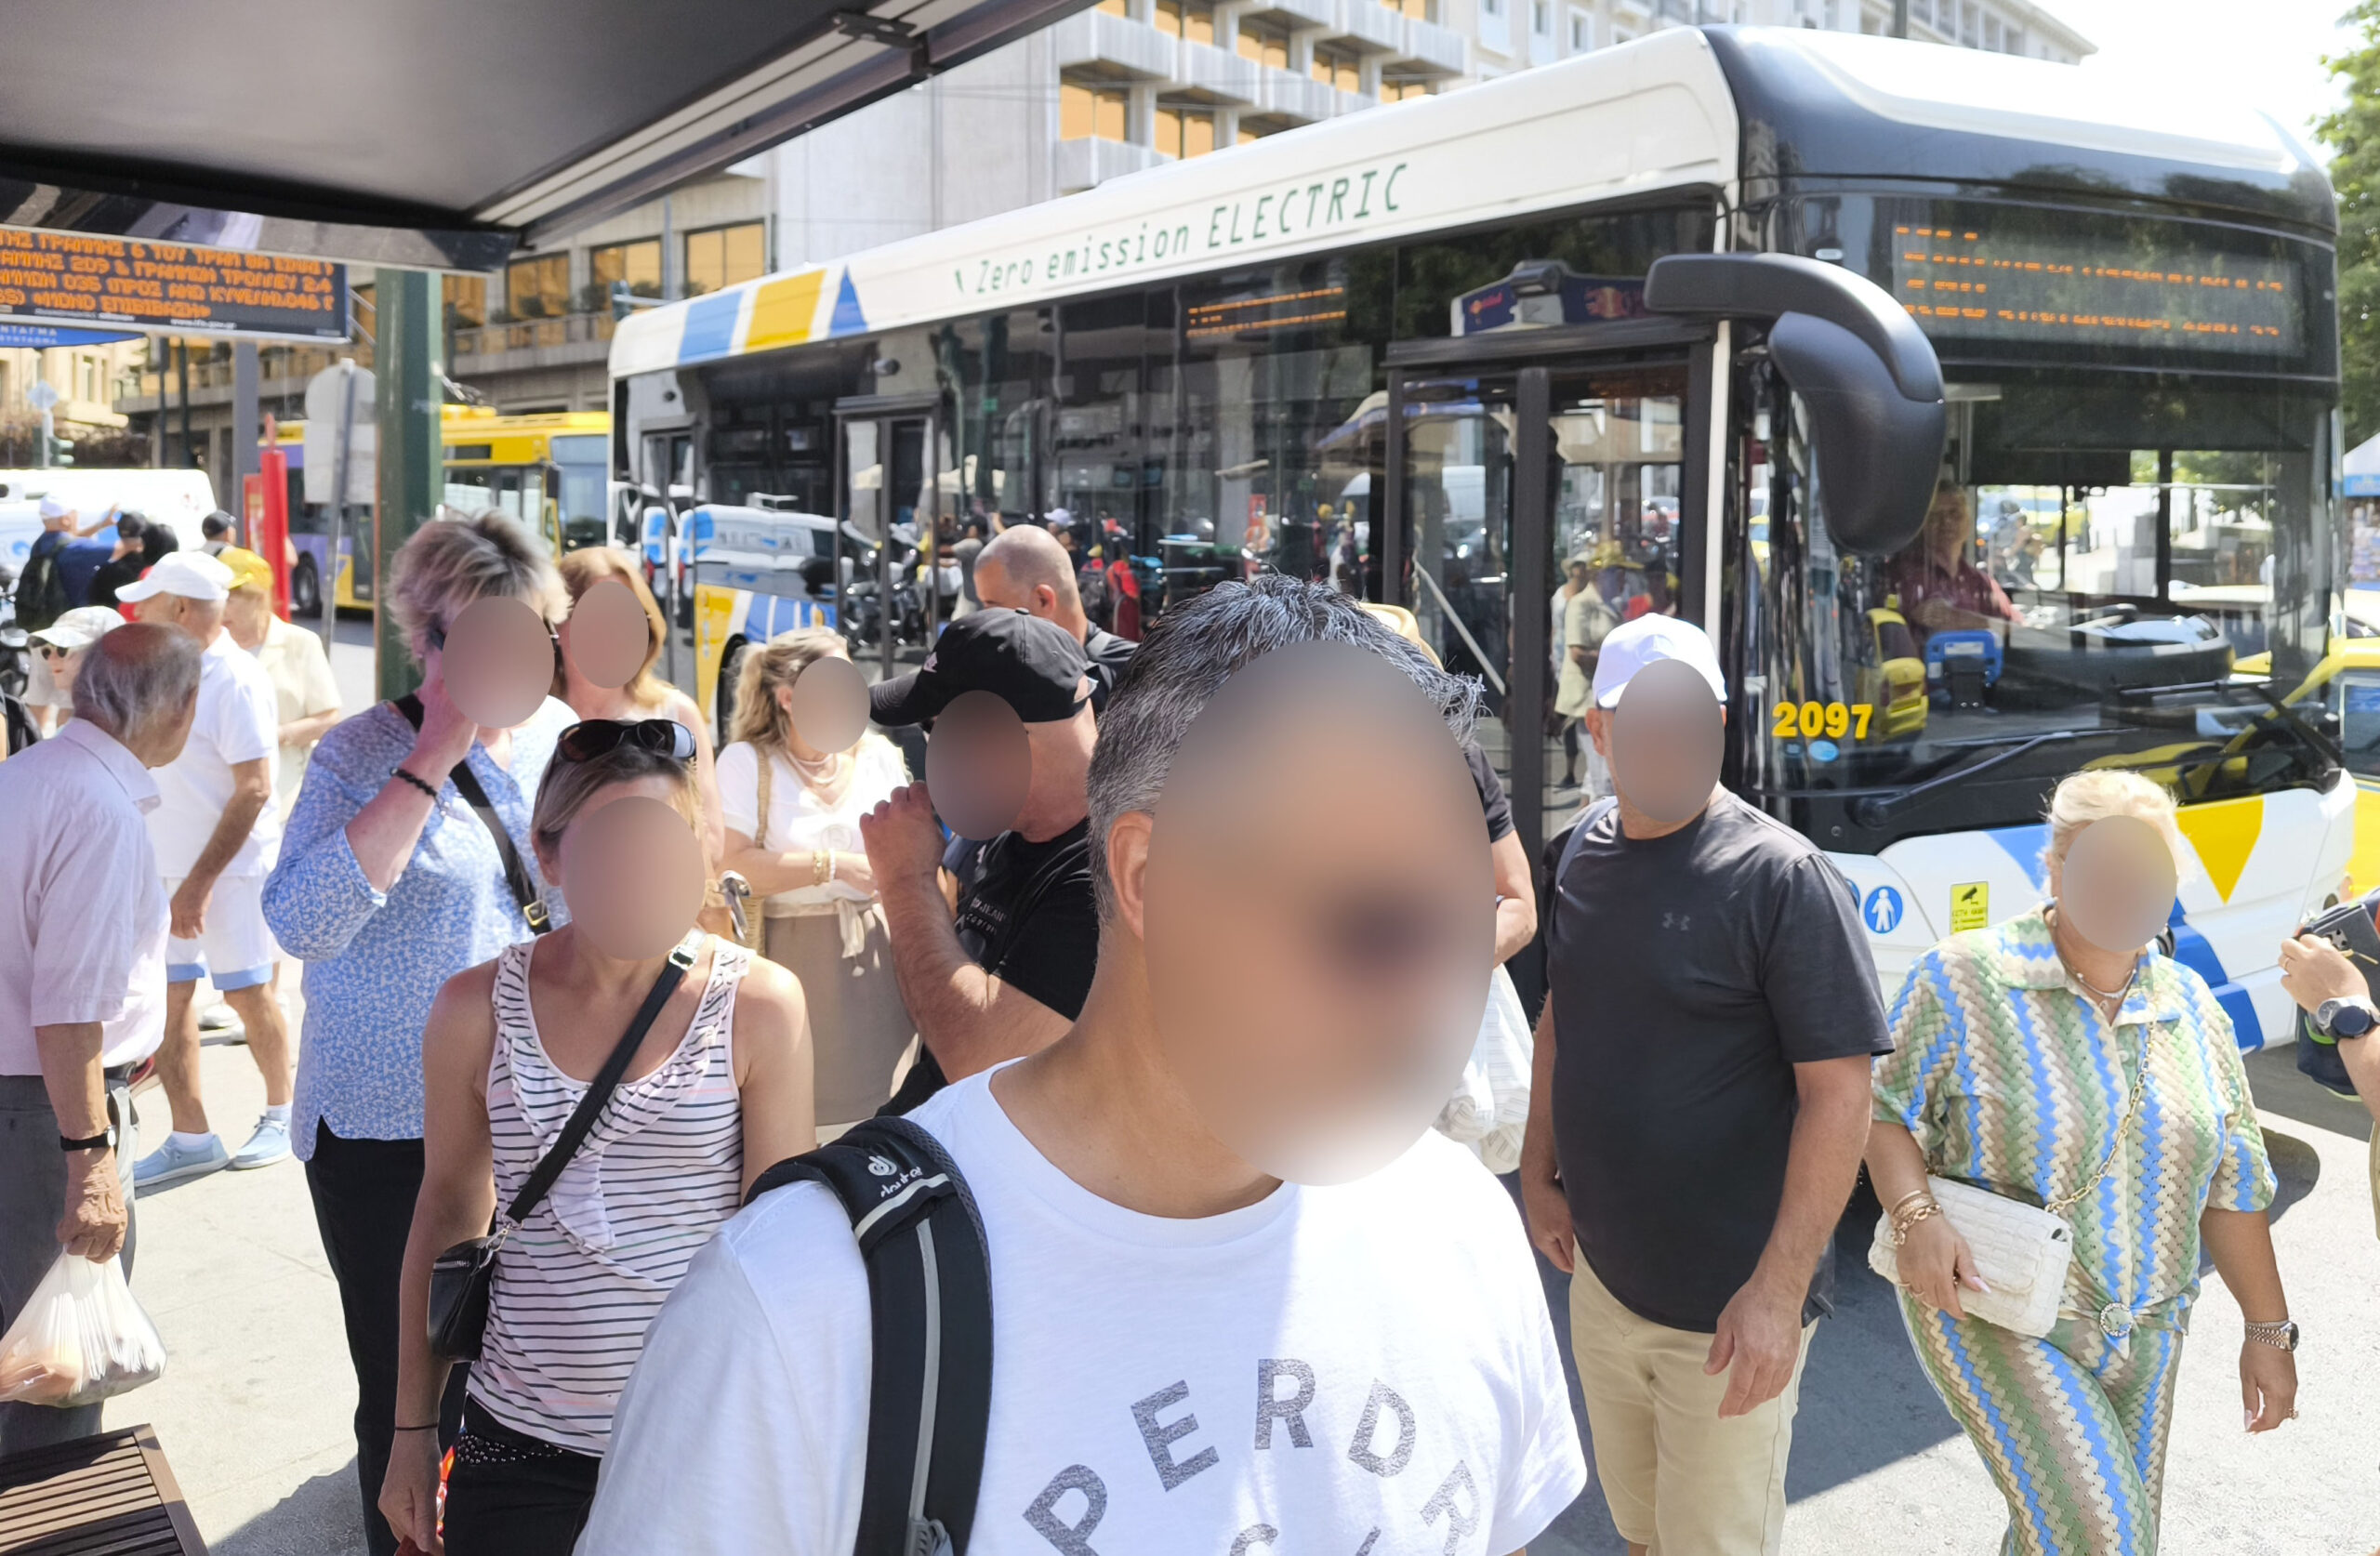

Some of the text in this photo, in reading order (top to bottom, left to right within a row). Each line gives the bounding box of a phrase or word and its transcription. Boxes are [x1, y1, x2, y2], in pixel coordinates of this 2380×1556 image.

[977, 164, 1408, 295] Zero emission ELECTRIC
[1771, 701, 1874, 740] 2097
